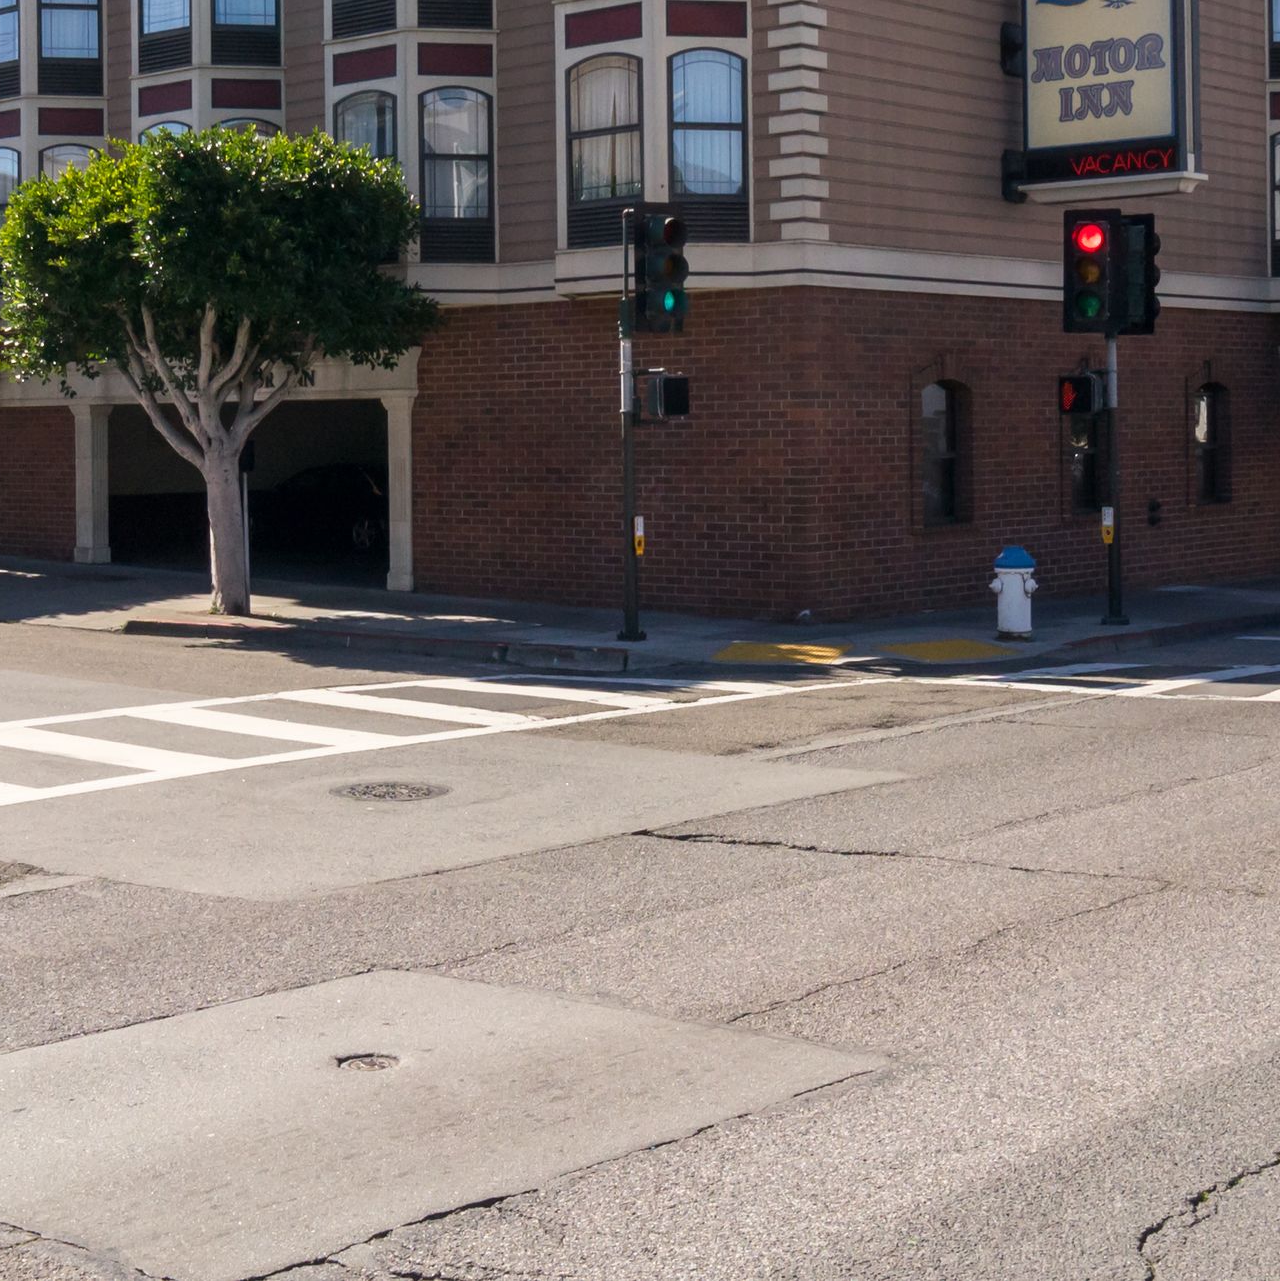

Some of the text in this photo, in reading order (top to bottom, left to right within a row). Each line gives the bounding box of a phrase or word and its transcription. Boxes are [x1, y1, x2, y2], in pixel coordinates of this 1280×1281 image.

[1031, 33, 1166, 83] MOTOR
[1059, 80, 1134, 122] INN
[1071, 149, 1173, 176] VACANCY
